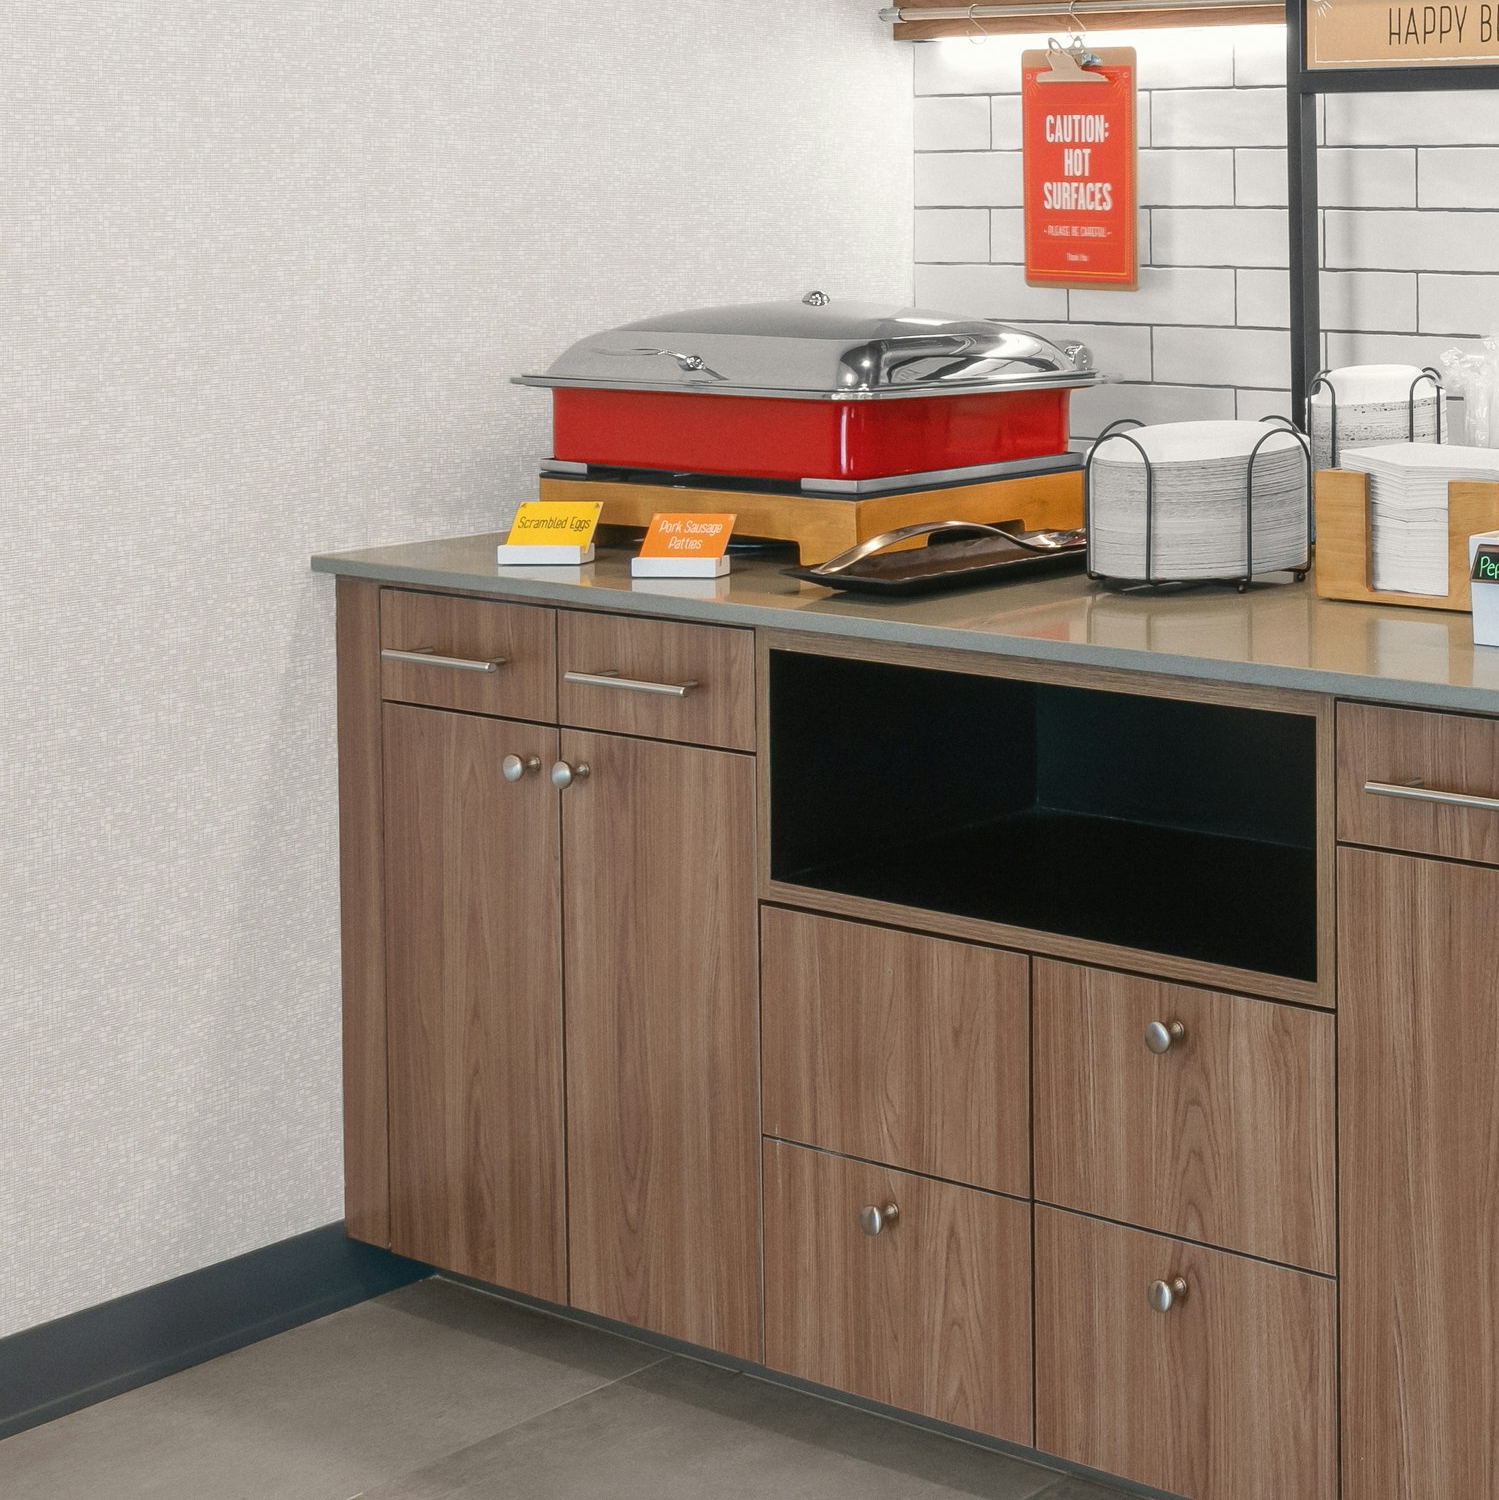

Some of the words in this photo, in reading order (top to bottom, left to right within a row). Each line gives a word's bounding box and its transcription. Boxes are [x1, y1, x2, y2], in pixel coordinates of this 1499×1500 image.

[1388, 5, 1468, 45] HAPPY
[1046, 115, 1110, 143] CAUTION:
[1064, 148, 1091, 176] HOT
[1043, 182, 1112, 211] SURFACES
[518, 516, 568, 529] Scrambled
[570, 517, 592, 532] Eggs
[659, 520, 682, 533] Pork
[684, 521, 724, 536] Sausage
[668, 536, 703, 550] Patties
